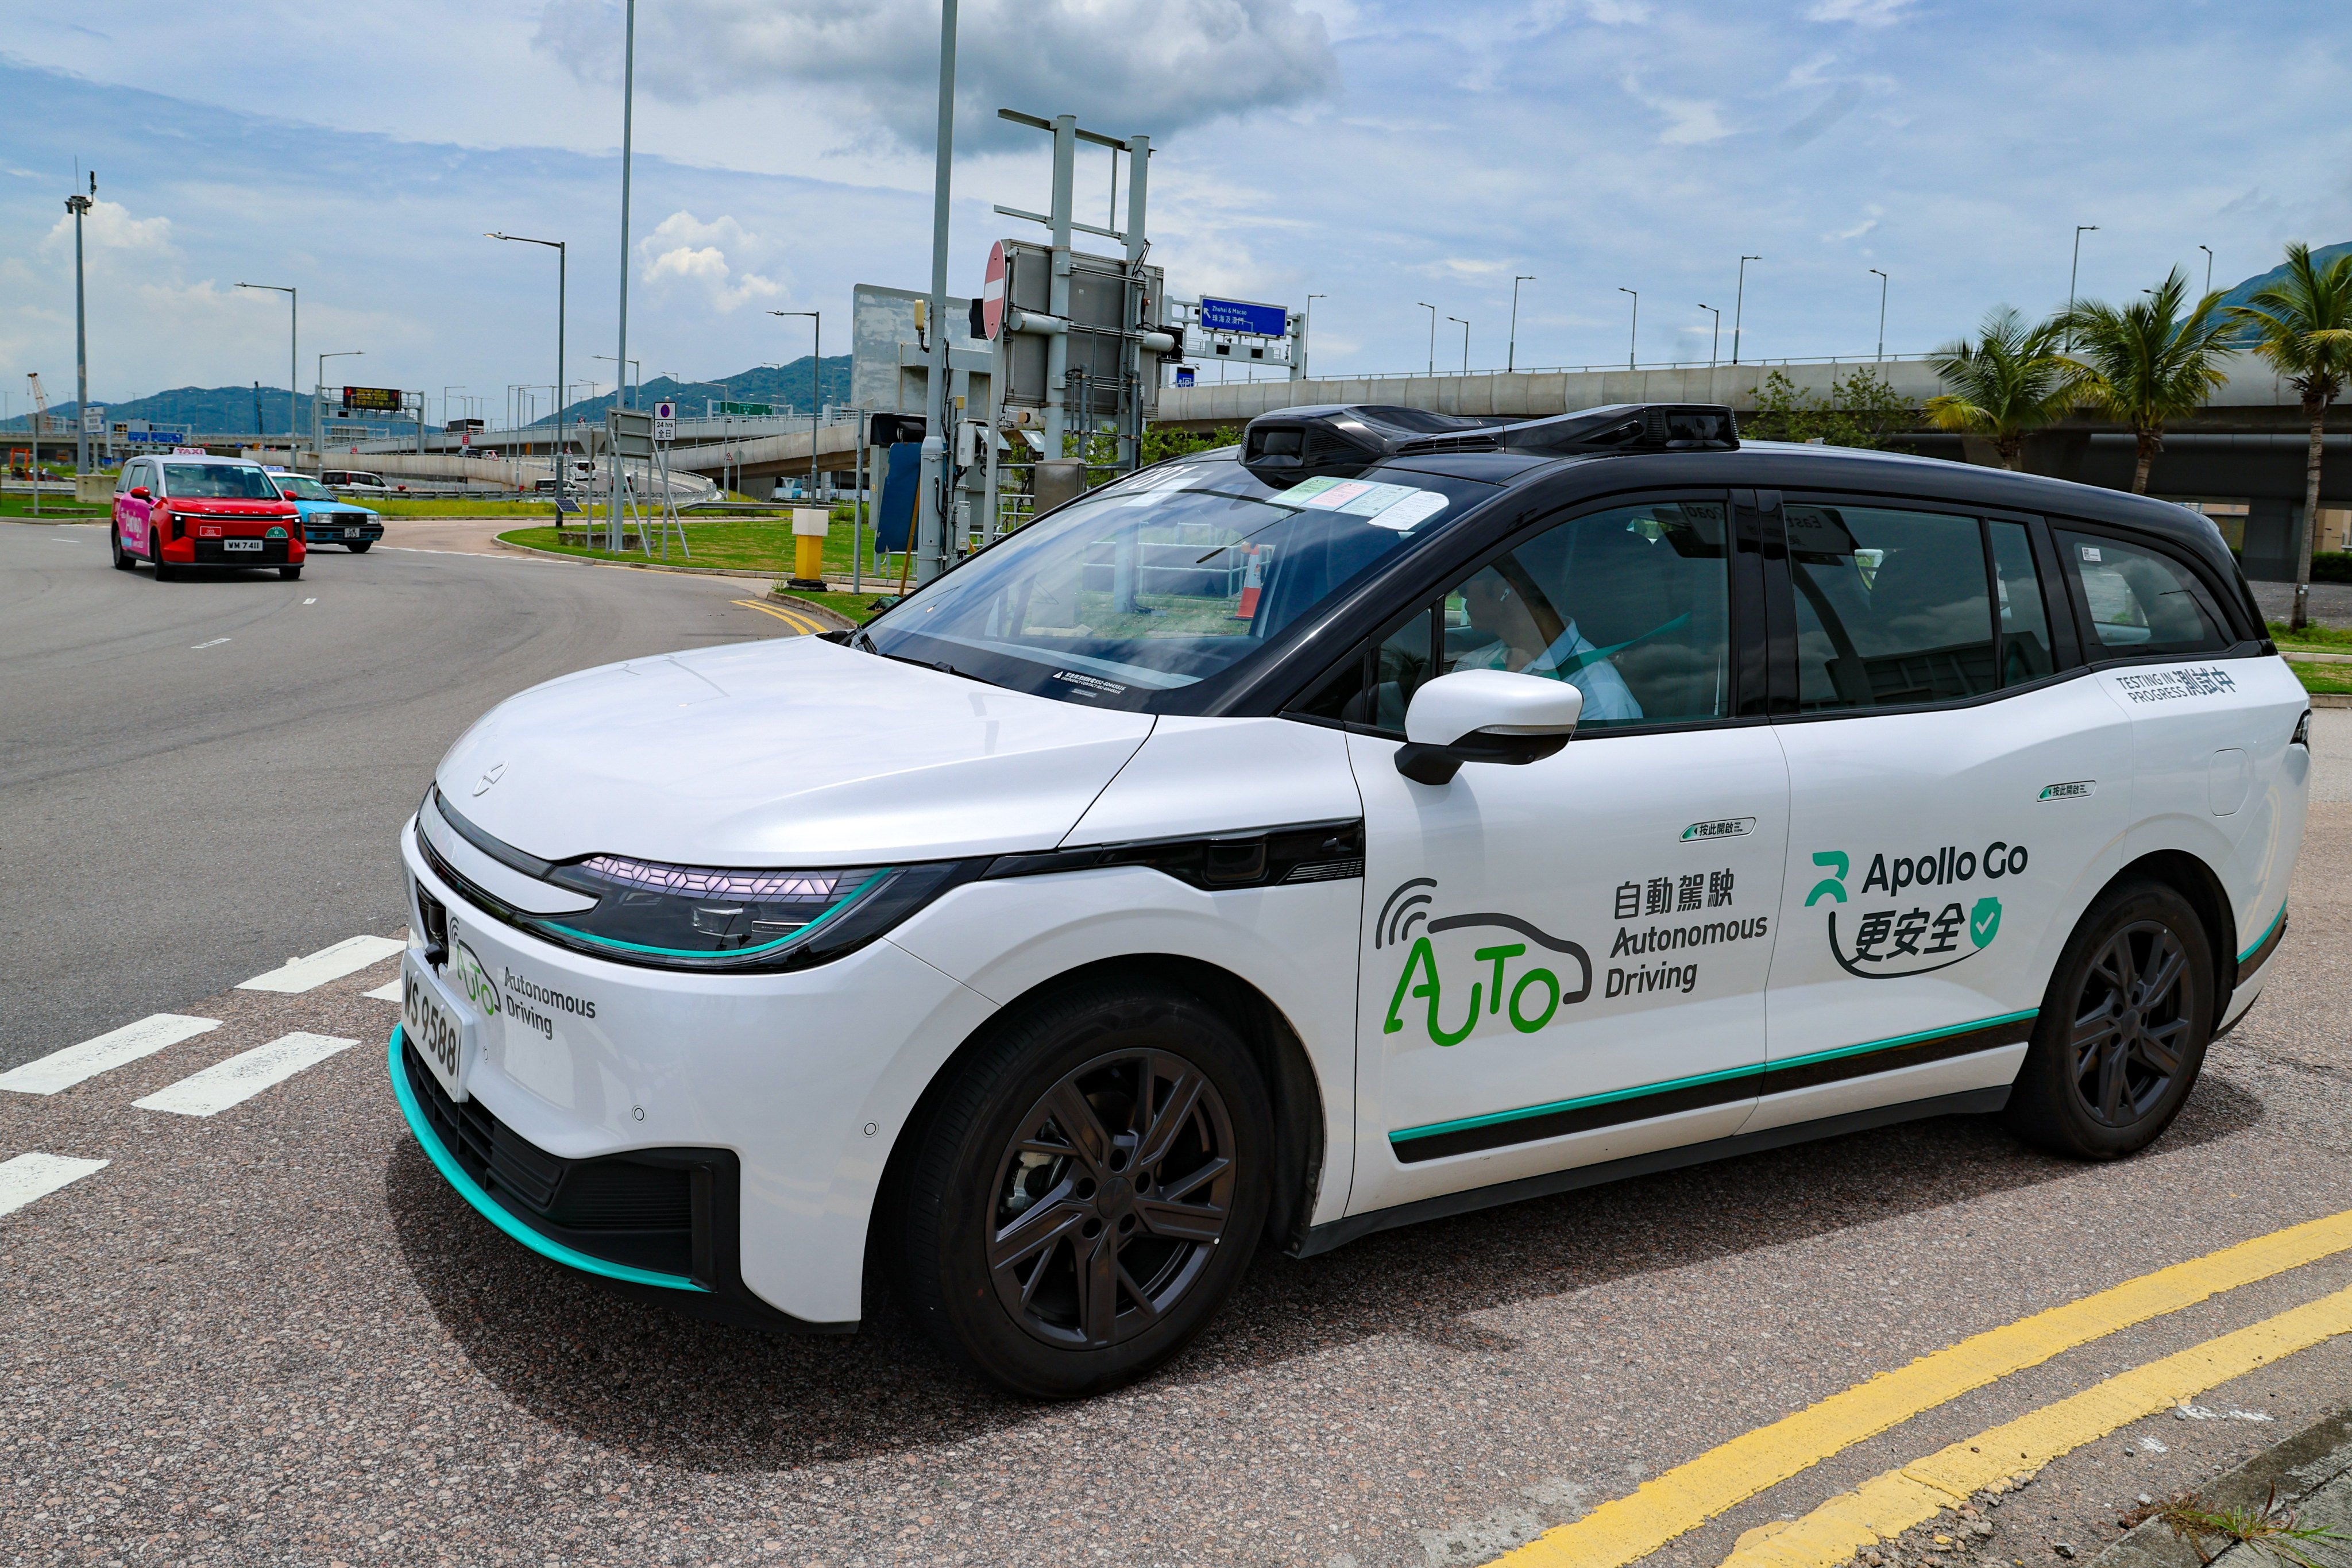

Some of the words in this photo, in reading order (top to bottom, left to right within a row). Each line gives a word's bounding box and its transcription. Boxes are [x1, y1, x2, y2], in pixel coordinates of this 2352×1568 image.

[658, 430, 671, 438] 全日
[2116, 673, 2164, 689] TESTING
[2160, 673, 2176, 684] IN
[2127, 686, 2188, 703] PROGRESS
[2172, 666, 2237, 696] 測試中
[1700, 821, 1733, 836] 按此開啟
[1861, 846, 1977, 897] Apollo
[1983, 841, 2029, 879] Go
[1614, 867, 1735, 920] 自動駕駛
[1609, 916, 1768, 958] Autonomous
[1855, 902, 1965, 964] 更安全
[504, 966, 596, 1019] Autonomous
[1605, 960, 1698, 999] Driving
[404, 970, 418, 1027] WS
[422, 996, 457, 1077] 9588
[506, 994, 553, 1041] Driving
